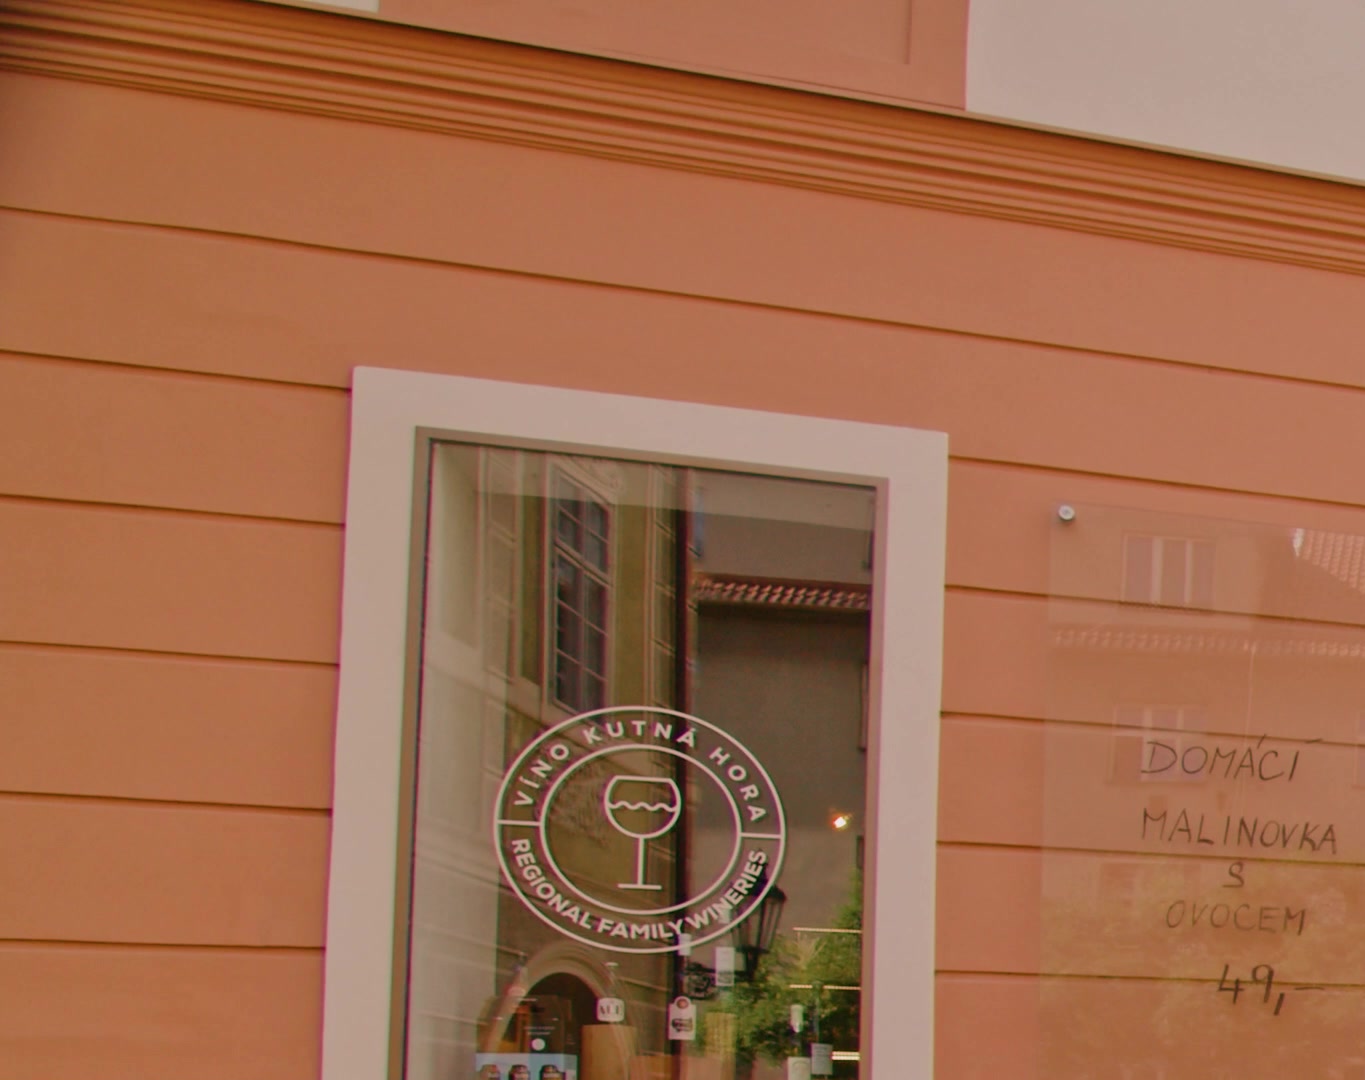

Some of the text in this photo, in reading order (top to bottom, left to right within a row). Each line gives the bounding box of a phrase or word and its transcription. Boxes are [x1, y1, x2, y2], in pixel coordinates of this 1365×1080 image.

[514, 719, 767, 822] VÍNO KUTNÁ HORA
[1141, 808, 1338, 855] MALINOVKA
[511, 838, 768, 941] REGIONAL FAMILY WINERIES
[1165, 902, 1306, 936] OVOCEM
